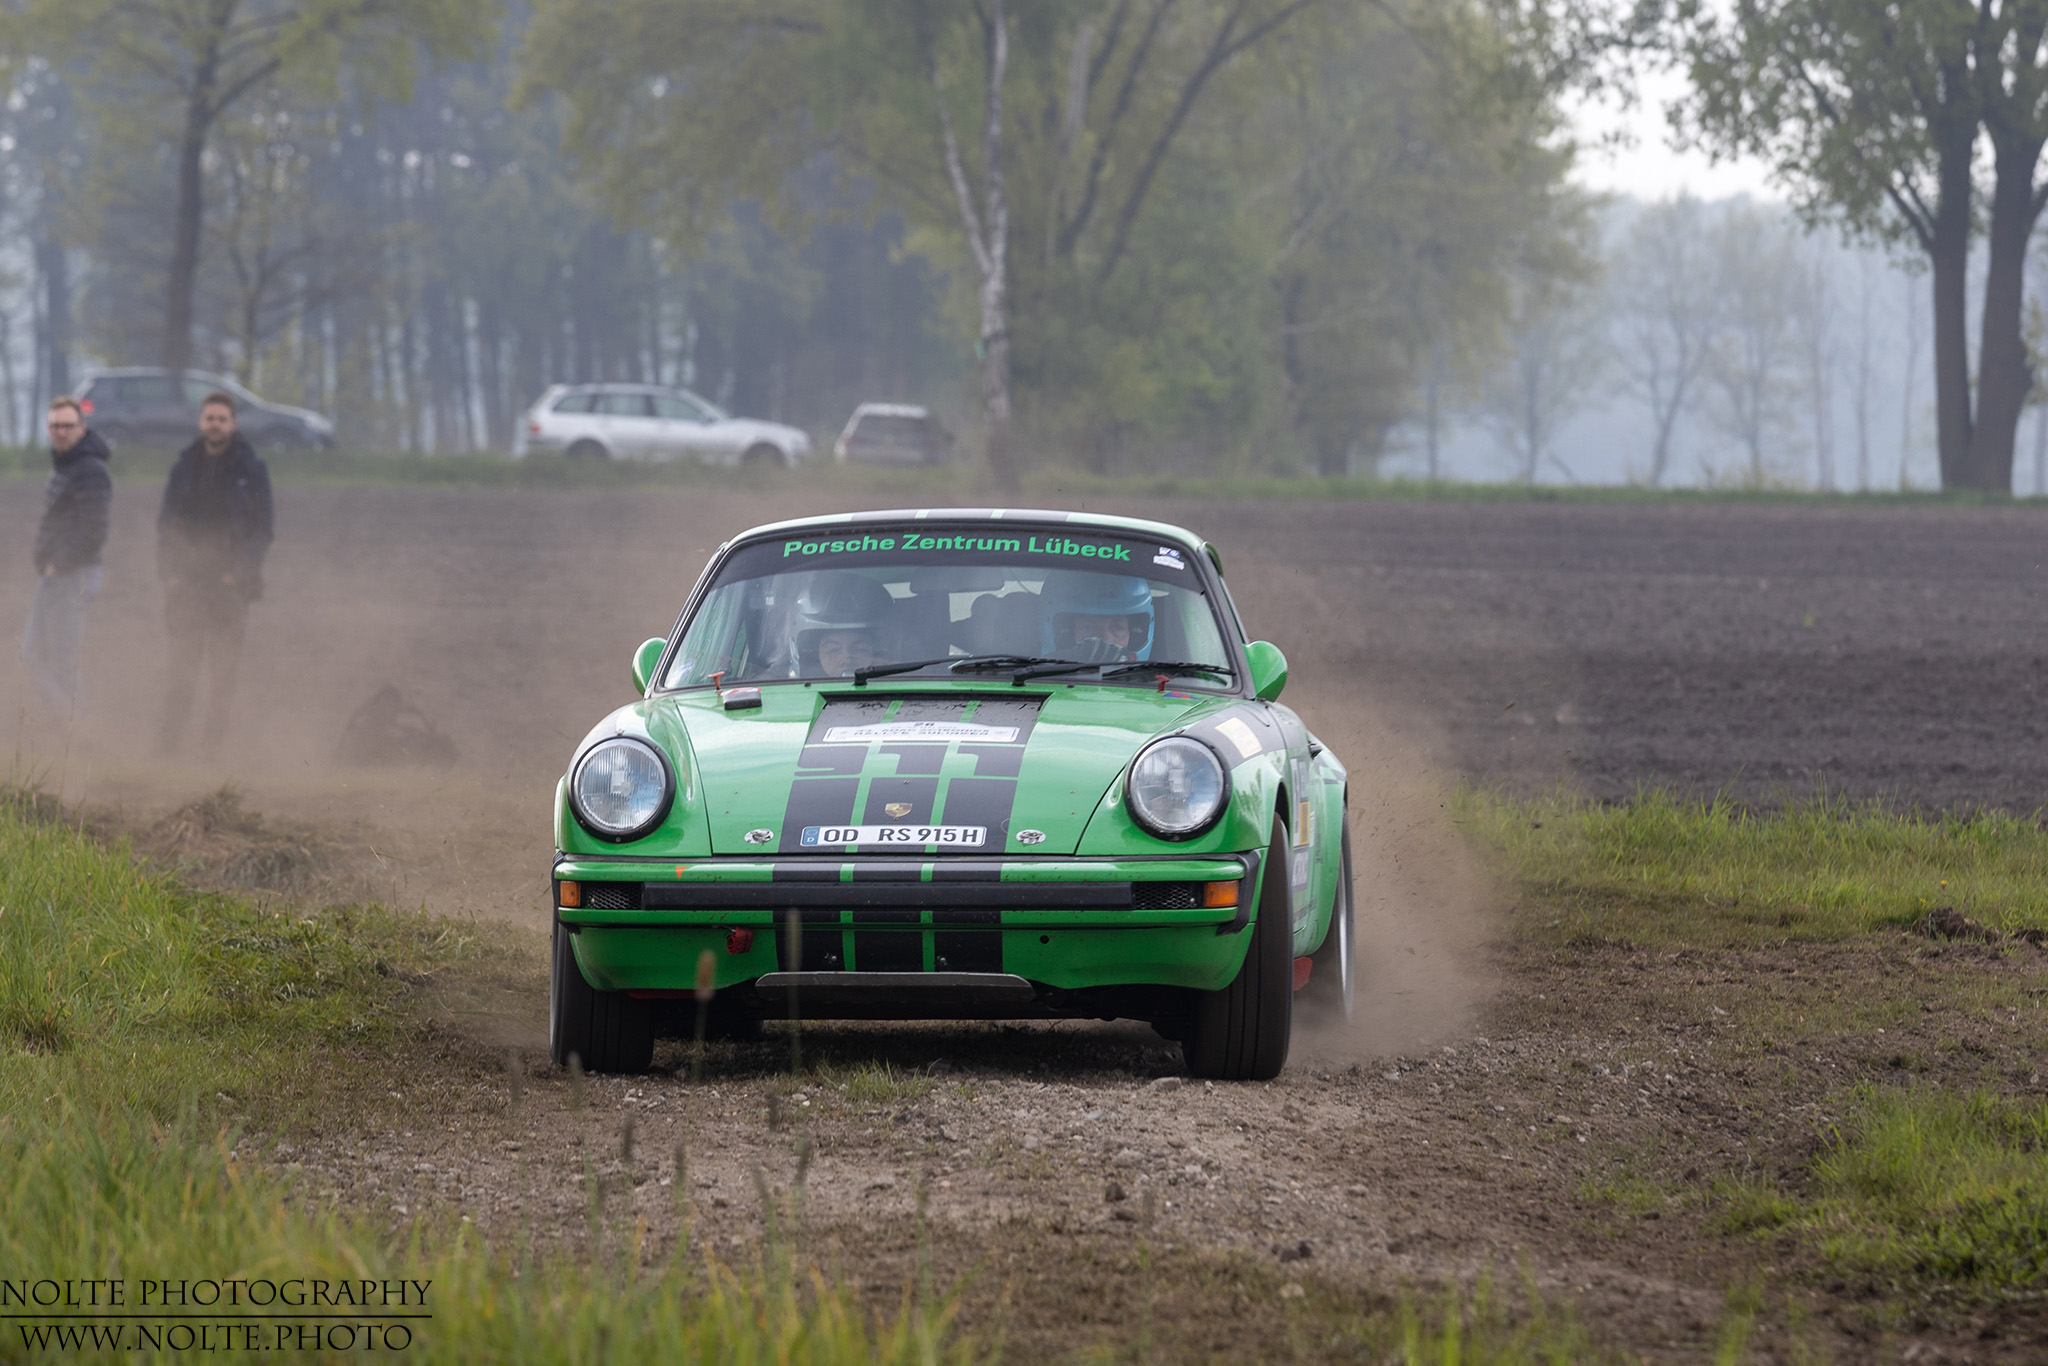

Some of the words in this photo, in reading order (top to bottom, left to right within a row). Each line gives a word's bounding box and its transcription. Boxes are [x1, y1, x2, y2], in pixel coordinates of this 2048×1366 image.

[783, 535, 895, 557] Porsche
[901, 533, 1020, 552] Zentrum
[1028, 536, 1131, 561] Lübeck
[823, 829, 859, 842] OD
[877, 828, 912, 842] RS
